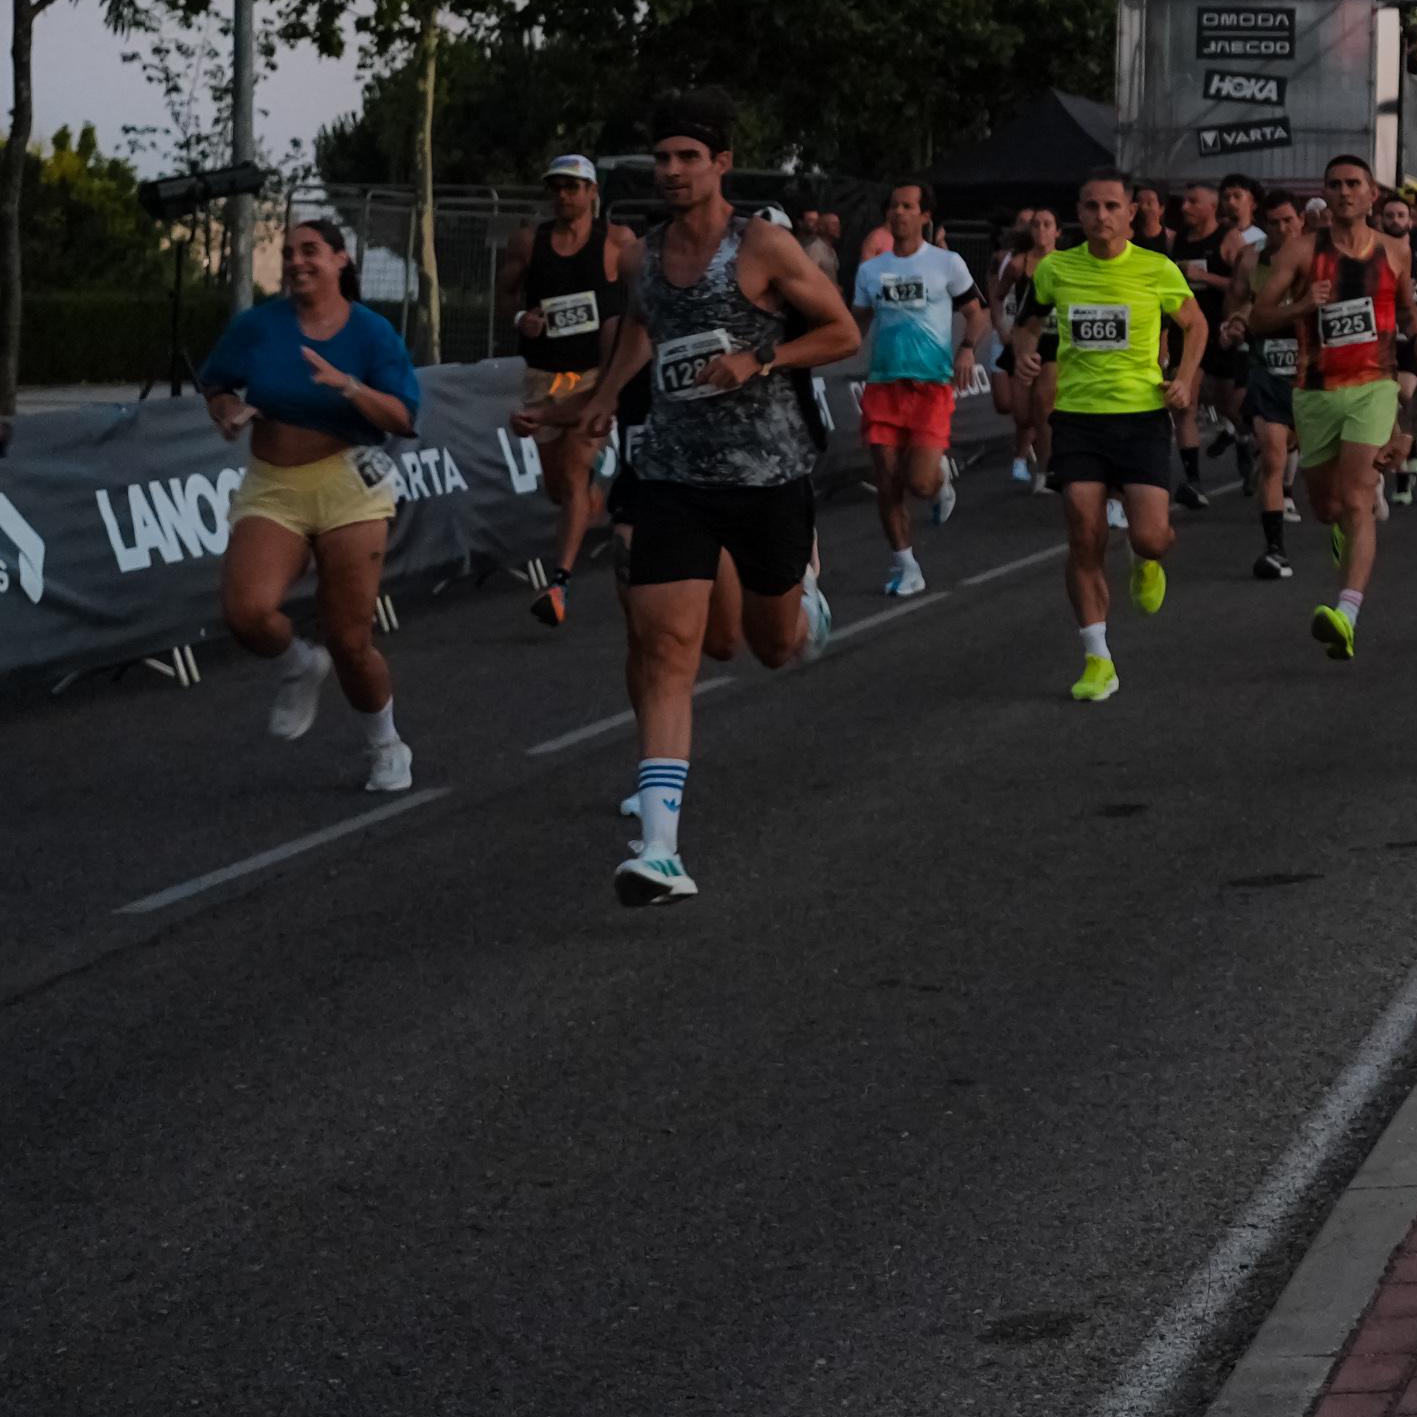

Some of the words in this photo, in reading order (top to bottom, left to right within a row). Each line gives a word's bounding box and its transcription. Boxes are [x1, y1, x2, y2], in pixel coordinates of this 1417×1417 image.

[1202, 12, 1290, 27] OMODA
[1202, 40, 1291, 55] JAECOO
[1209, 73, 1279, 102] HOKA
[1222, 125, 1289, 146] VARTA
[1080, 321, 1118, 340] 666
[1329, 314, 1366, 337] 225
[1267, 350, 1298, 367] 170
[391, 446, 469, 505] ARTA
